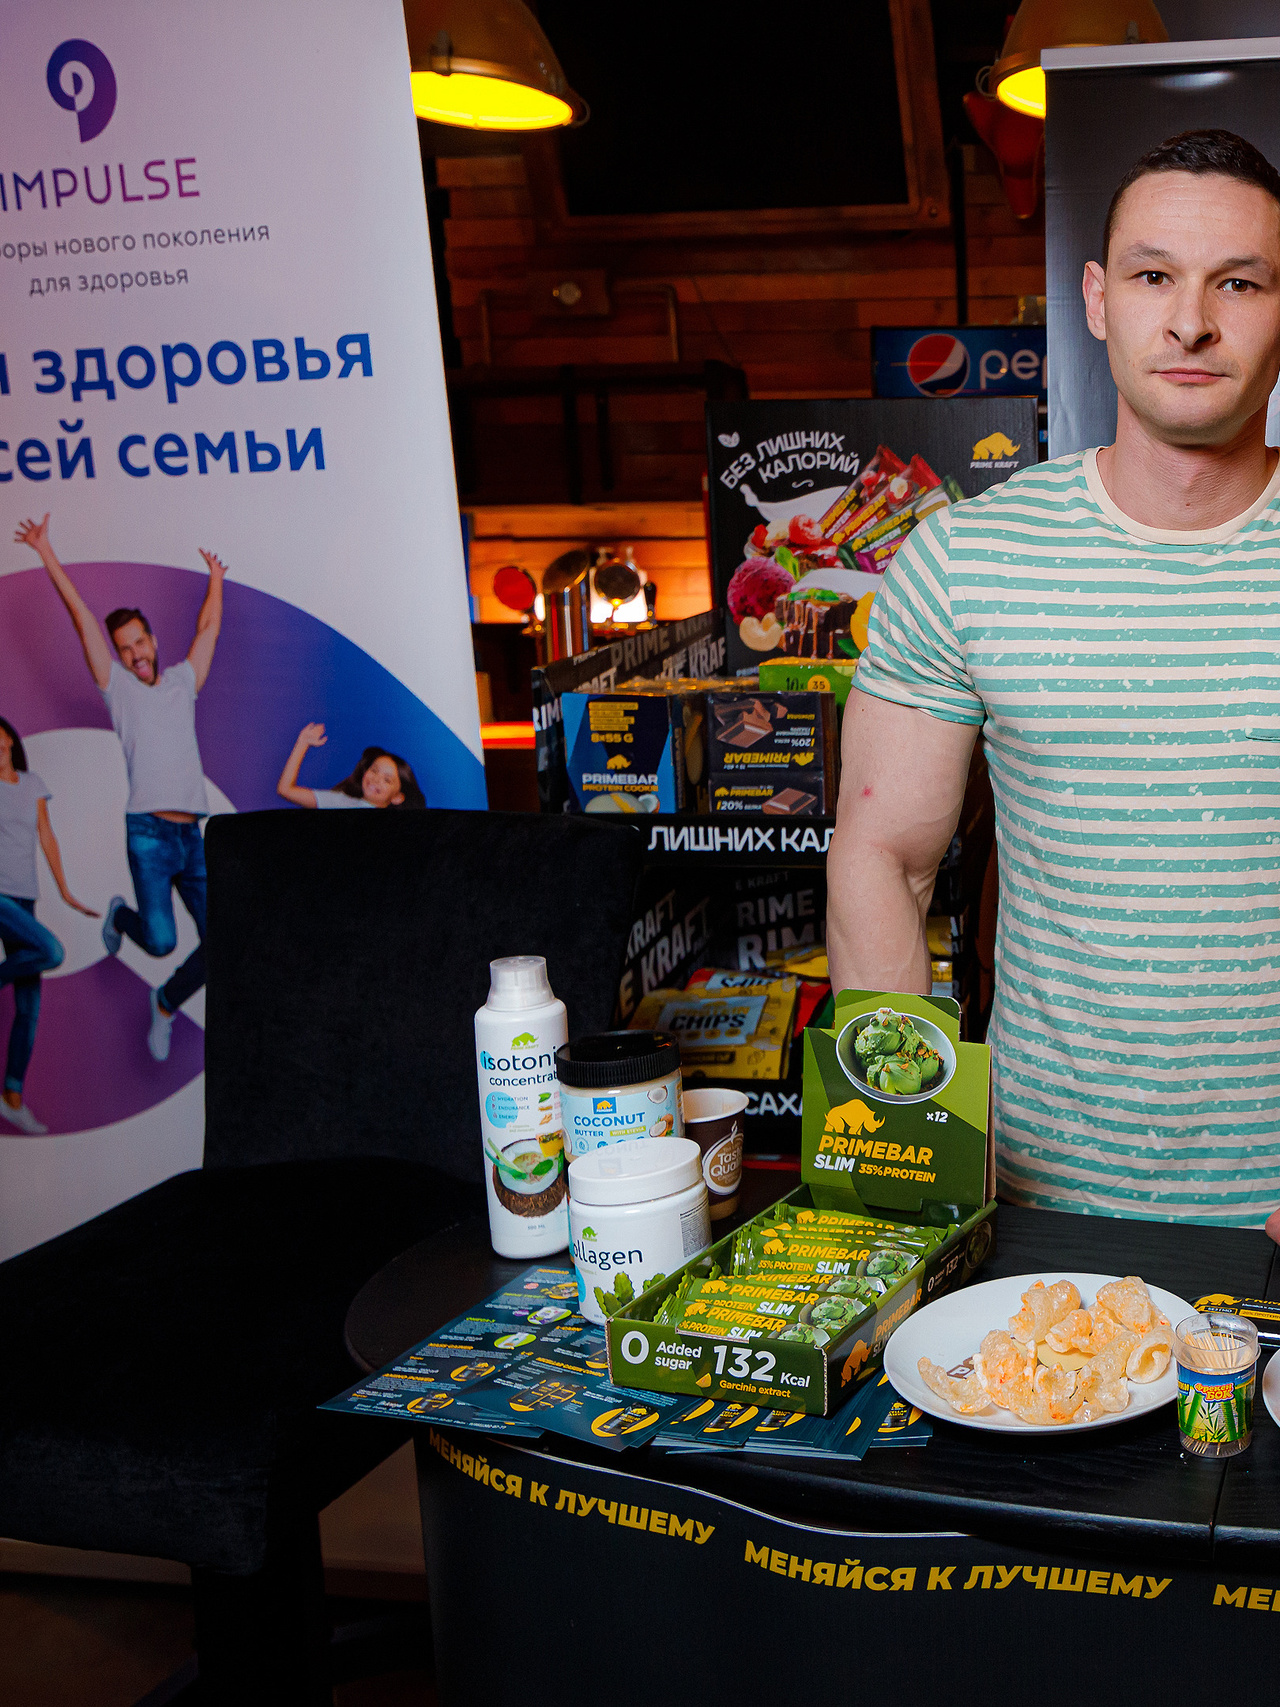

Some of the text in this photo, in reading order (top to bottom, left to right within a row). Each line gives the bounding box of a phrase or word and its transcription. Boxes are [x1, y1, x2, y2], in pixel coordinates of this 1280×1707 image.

[0, 224, 270, 263] оры нового поколения
[29, 268, 188, 297] для здоровья
[32, 332, 374, 404] здоровья
[979, 348, 1047, 390] pe
[118, 427, 326, 477] семьи
[719, 430, 846, 489] БЕЗ ЛИШНИХ
[758, 451, 860, 484] КАЛОРИЙ
[970, 460, 1019, 469] PRIME KRAFT
[791, 738, 811, 747] 20%
[724, 752, 791, 764] PRIMEBAR
[582, 773, 658, 785] PRIMEBAR
[730, 788, 773, 797] PRIMEBAR
[721, 801, 743, 811] 20%
[648, 826, 775, 852] ЛИШНИХ
[737, 888, 815, 927] RIME
[670, 1013, 746, 1031] CHIPS
[574, 1112, 645, 1127] COCONUT
[574, 1129, 604, 1137] BUTTER
[818, 1135, 934, 1166] PRIMEBAR
[813, 1154, 855, 1173] SLIM
[883, 1166, 936, 1183] PROTEIN
[786, 1243, 871, 1262] PRIMEBAR
[775, 1260, 850, 1275] PROTEIN SLIM
[729, 1285, 819, 1305] PRIMEBAR
[756, 1301, 795, 1316] SLIM
[875, 1288, 923, 1341] PRIMEBAR
[706, 1308, 787, 1332] PRIMEBAR
[688, 1321, 763, 1339] PROTEIN SLIM
[621, 1331, 649, 1365] 0
[656, 1341, 702, 1358] Added
[654, 1356, 692, 1371] sugar
[714, 1345, 810, 1388] 132 Kcal
[719, 1380, 791, 1398] Garcinia extract
[1195, 1383, 1234, 1393] Фрекен
[1206, 1391, 1233, 1400] БОК
[429, 1427, 715, 1545] МЕНЯЙСЯ К ЛУЧШЕМУ
[744, 1540, 1172, 1598] МЕНЯЙСЯ К ЛУЧШЕМУ
